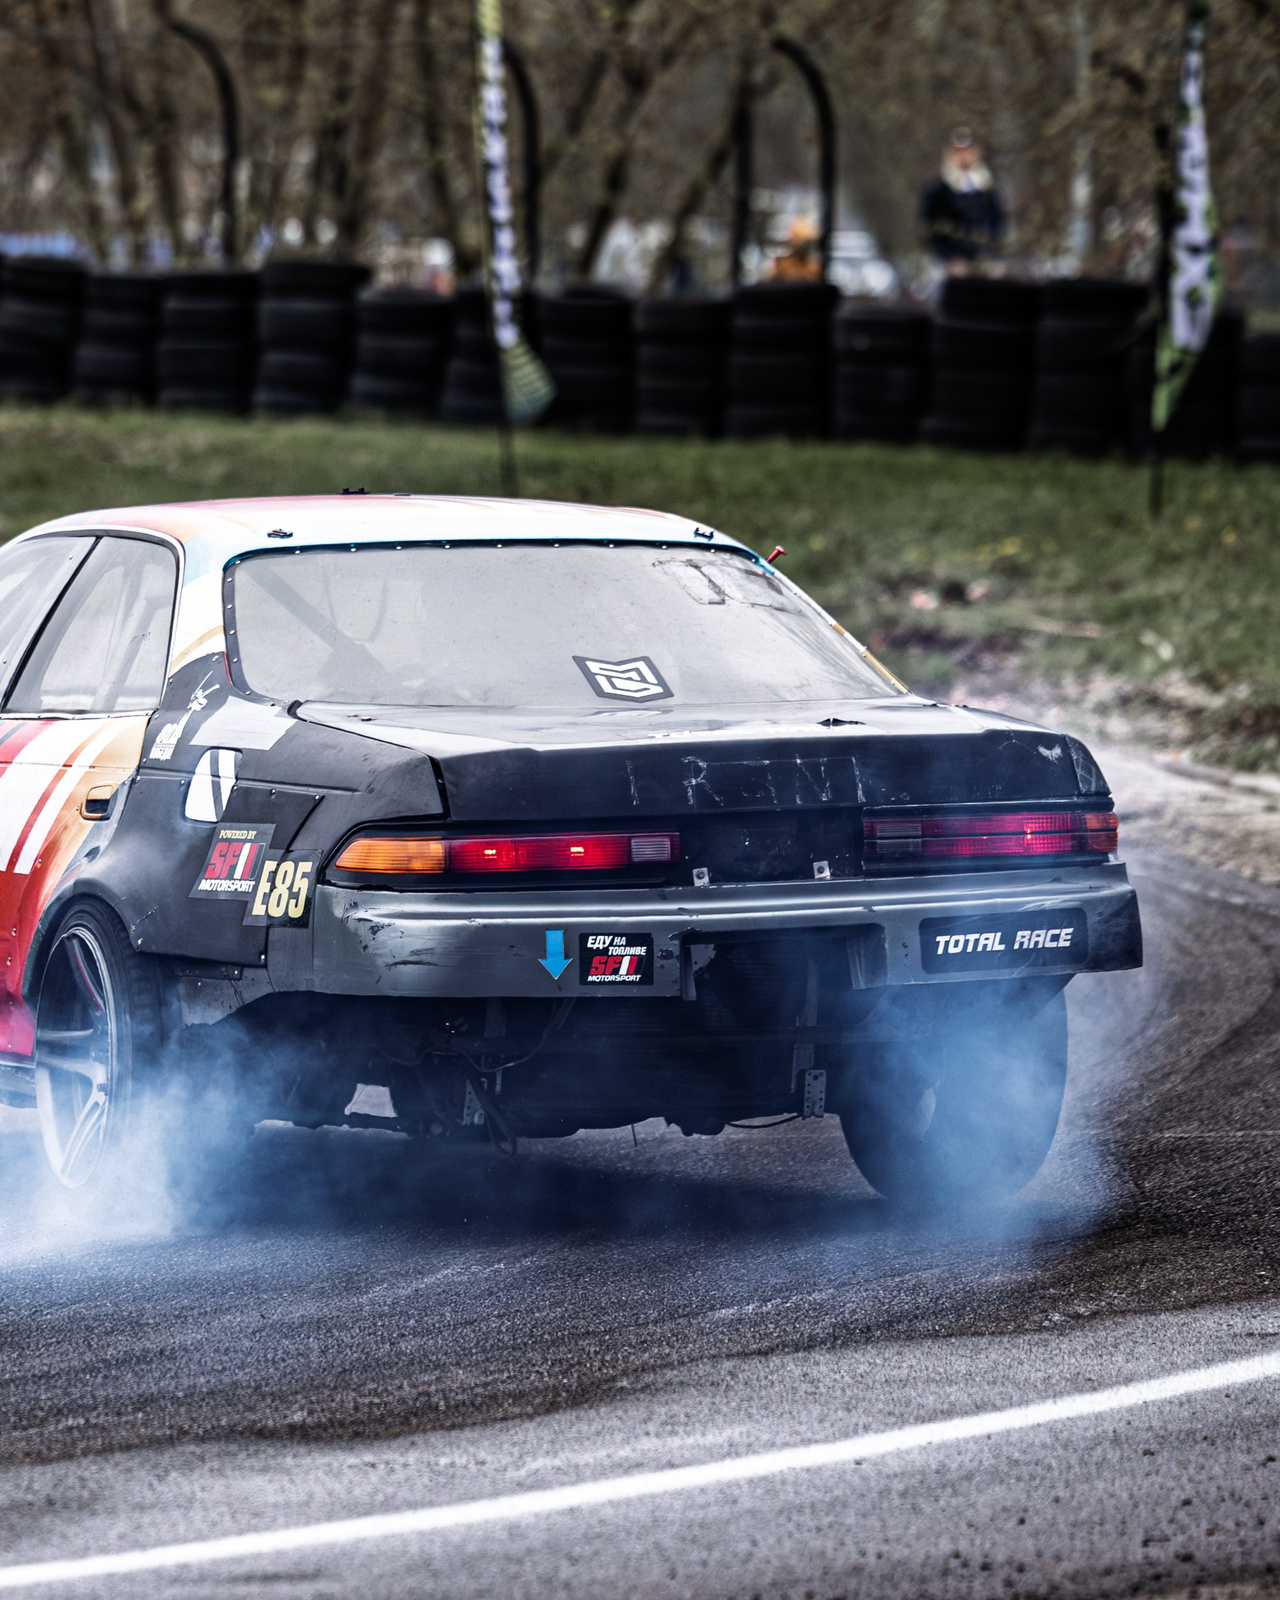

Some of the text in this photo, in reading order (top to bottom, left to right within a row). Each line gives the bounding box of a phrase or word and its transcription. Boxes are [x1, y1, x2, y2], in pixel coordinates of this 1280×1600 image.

[219, 830, 257, 839] POWERED BY
[198, 879, 255, 892] MOTORSPORT
[251, 860, 313, 918] E85
[587, 935, 626, 949] ЕДУ НА
[936, 928, 1074, 955] TOTAL RACE
[608, 946, 647, 956] ТОПЛИВЕ
[587, 974, 641, 982] MOTORSPORT
